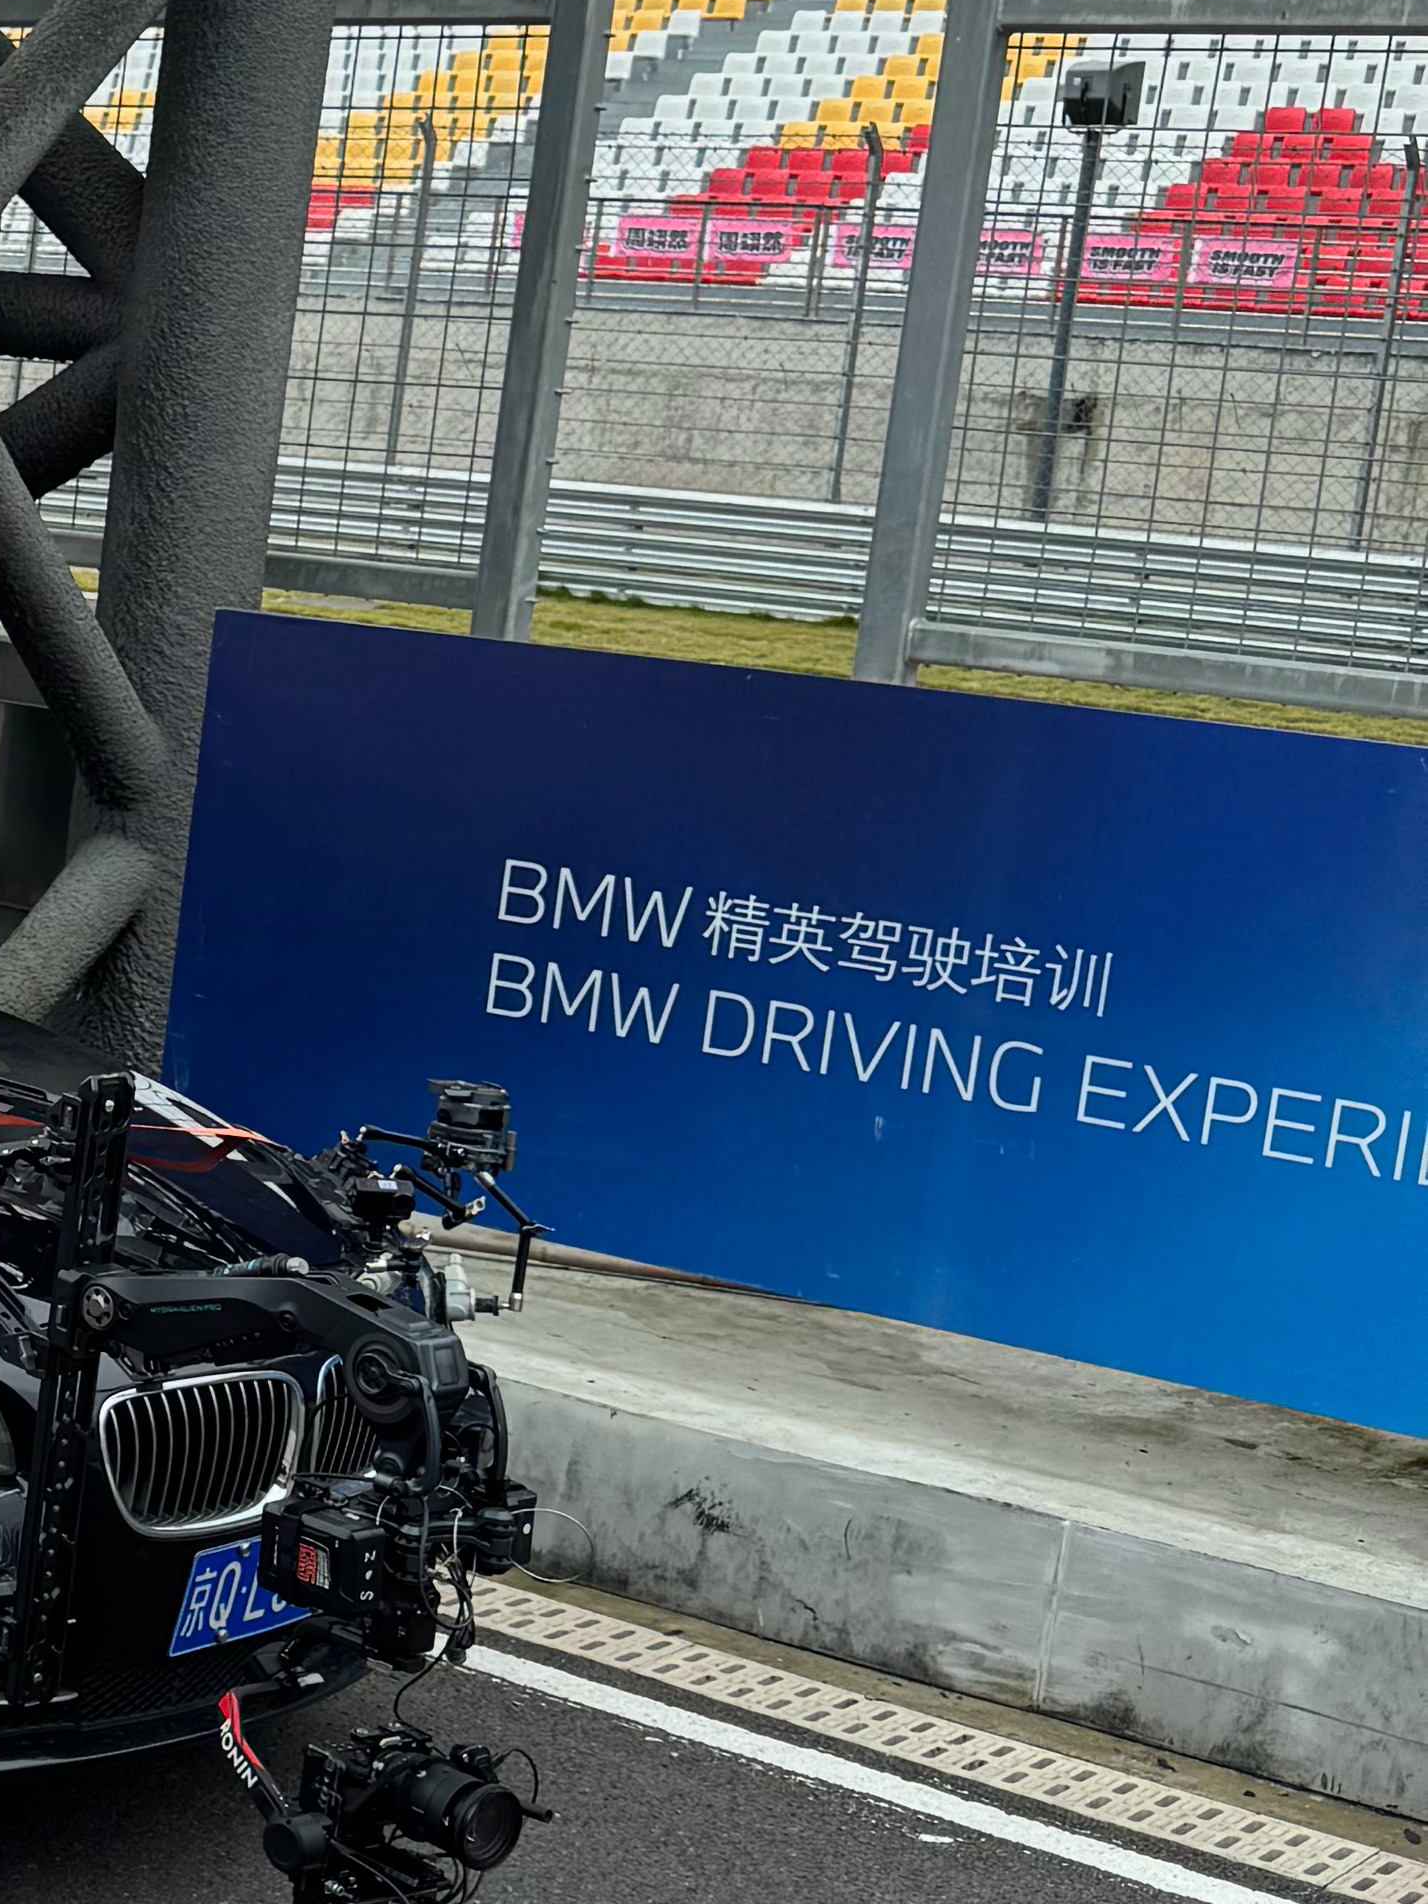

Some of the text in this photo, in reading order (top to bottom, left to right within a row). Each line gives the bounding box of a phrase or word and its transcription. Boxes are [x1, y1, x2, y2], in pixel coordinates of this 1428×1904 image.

[1090, 246, 1160, 260] SMOOTH
[1209, 249, 1286, 265] SMOOTH
[1091, 259, 1156, 272] IS FAST
[1211, 264, 1277, 278] IS FAST
[497, 858, 1114, 1019] BMW 精英驾驶培训
[485, 952, 680, 1045] BMW
[700, 988, 1044, 1113] DRIVING
[220, 1718, 258, 1789] RONIN
